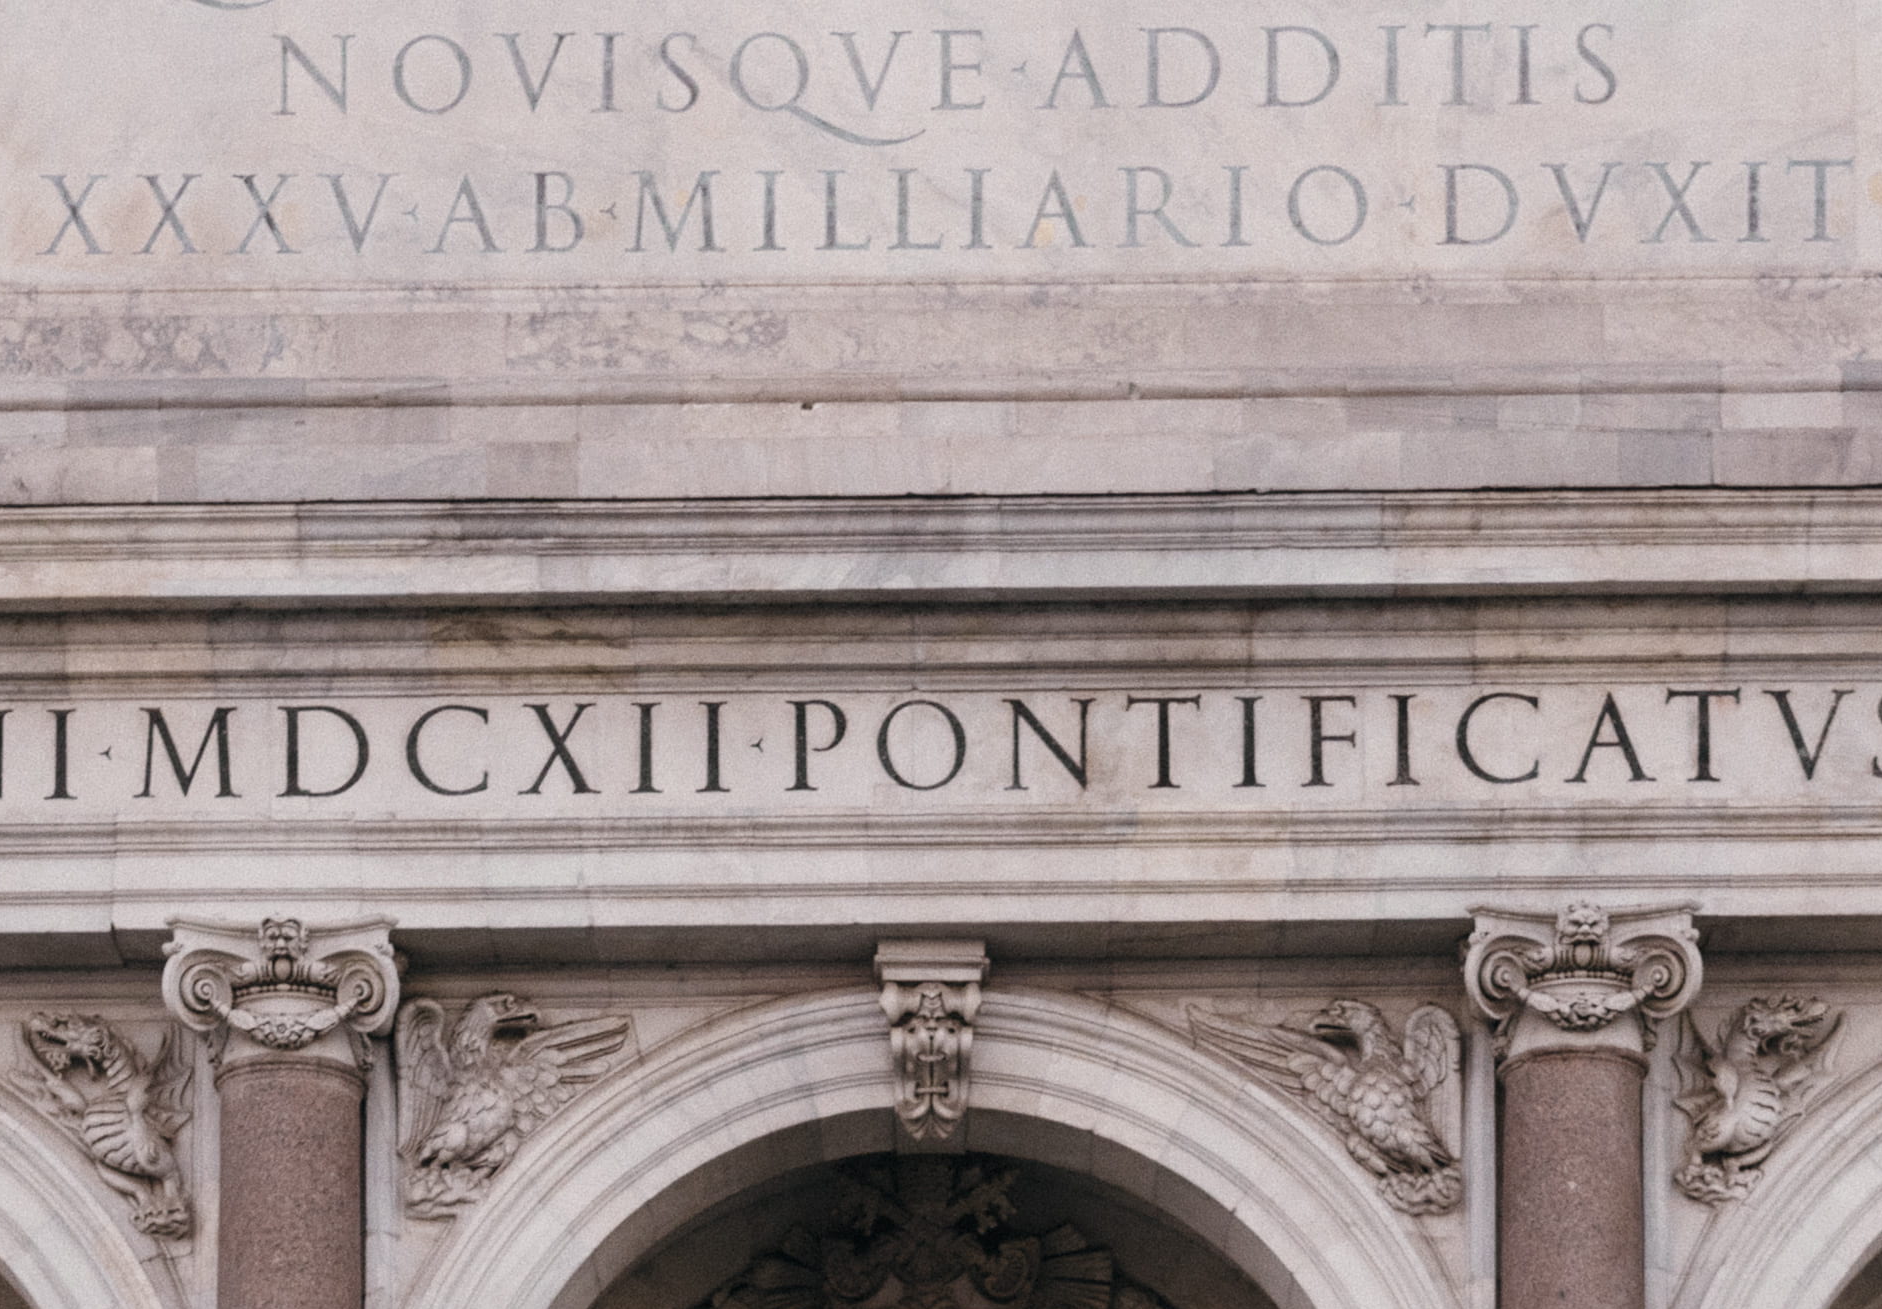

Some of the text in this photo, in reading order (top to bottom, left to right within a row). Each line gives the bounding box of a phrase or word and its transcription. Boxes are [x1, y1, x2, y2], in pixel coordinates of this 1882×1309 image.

[272, 22, 1618, 147] NOVISQVE ADDITIS
[36, 157, 1856, 256] XXXV AB MILLIARIO DVXIT
[134, 703, 730, 798] MDCXII
